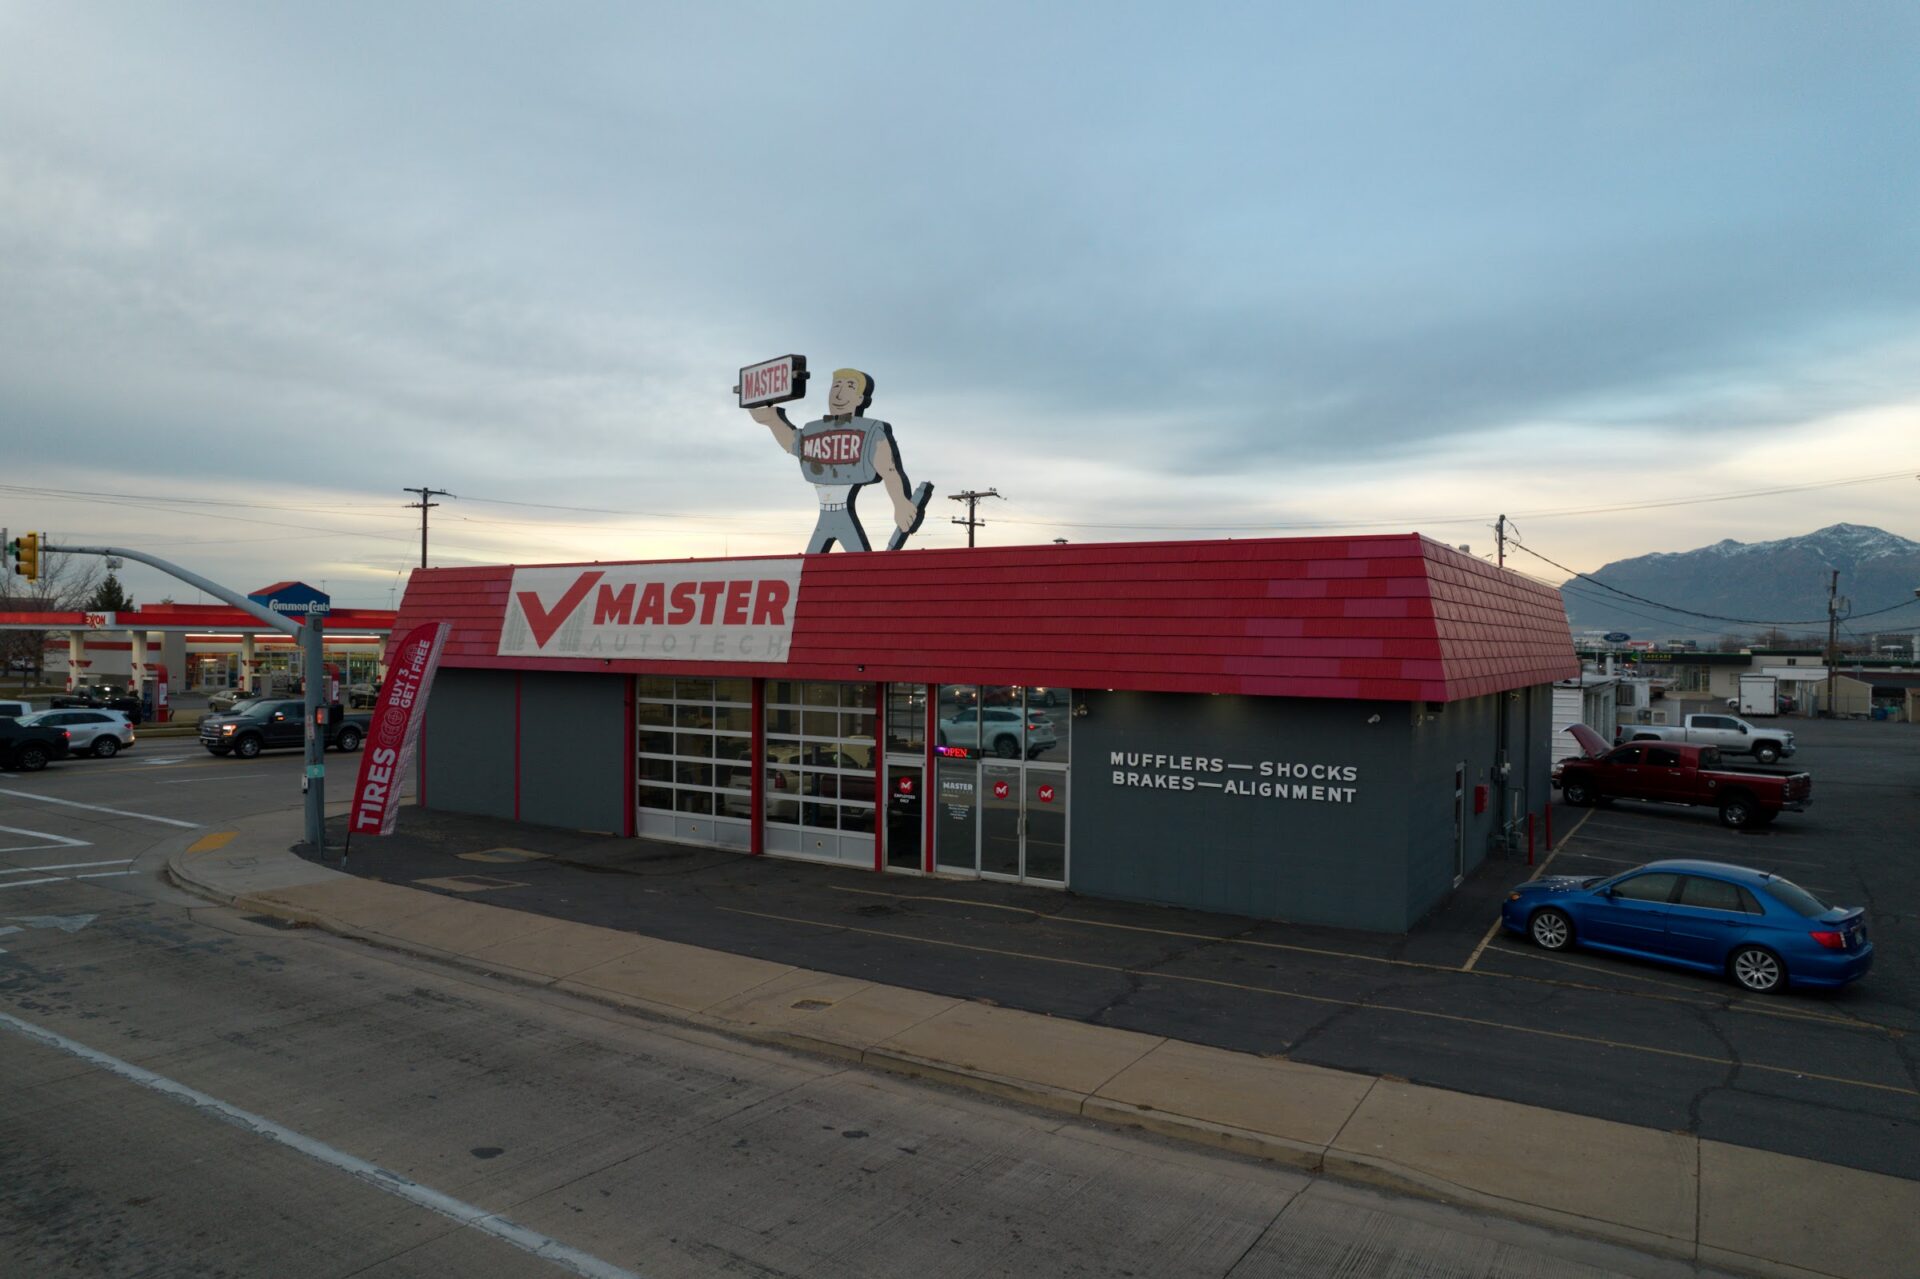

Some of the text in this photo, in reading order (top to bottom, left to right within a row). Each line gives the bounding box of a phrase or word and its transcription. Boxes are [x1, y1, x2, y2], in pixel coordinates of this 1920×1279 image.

[745, 364, 788, 400] MASTER
[804, 435, 860, 460] MASTER
[269, 599, 329, 613] Common Cents
[593, 580, 790, 625] MASTER
[590, 632, 784, 655] AUTOTECH
[400, 682, 416, 708] GET
[411, 639, 430, 672] FREE
[388, 668, 409, 706] BUY 3
[943, 748, 969, 758] OPEN
[1259, 761, 1358, 781] SHOCKS
[356, 747, 396, 829] TIRES
[943, 782, 973, 790] MASTER
